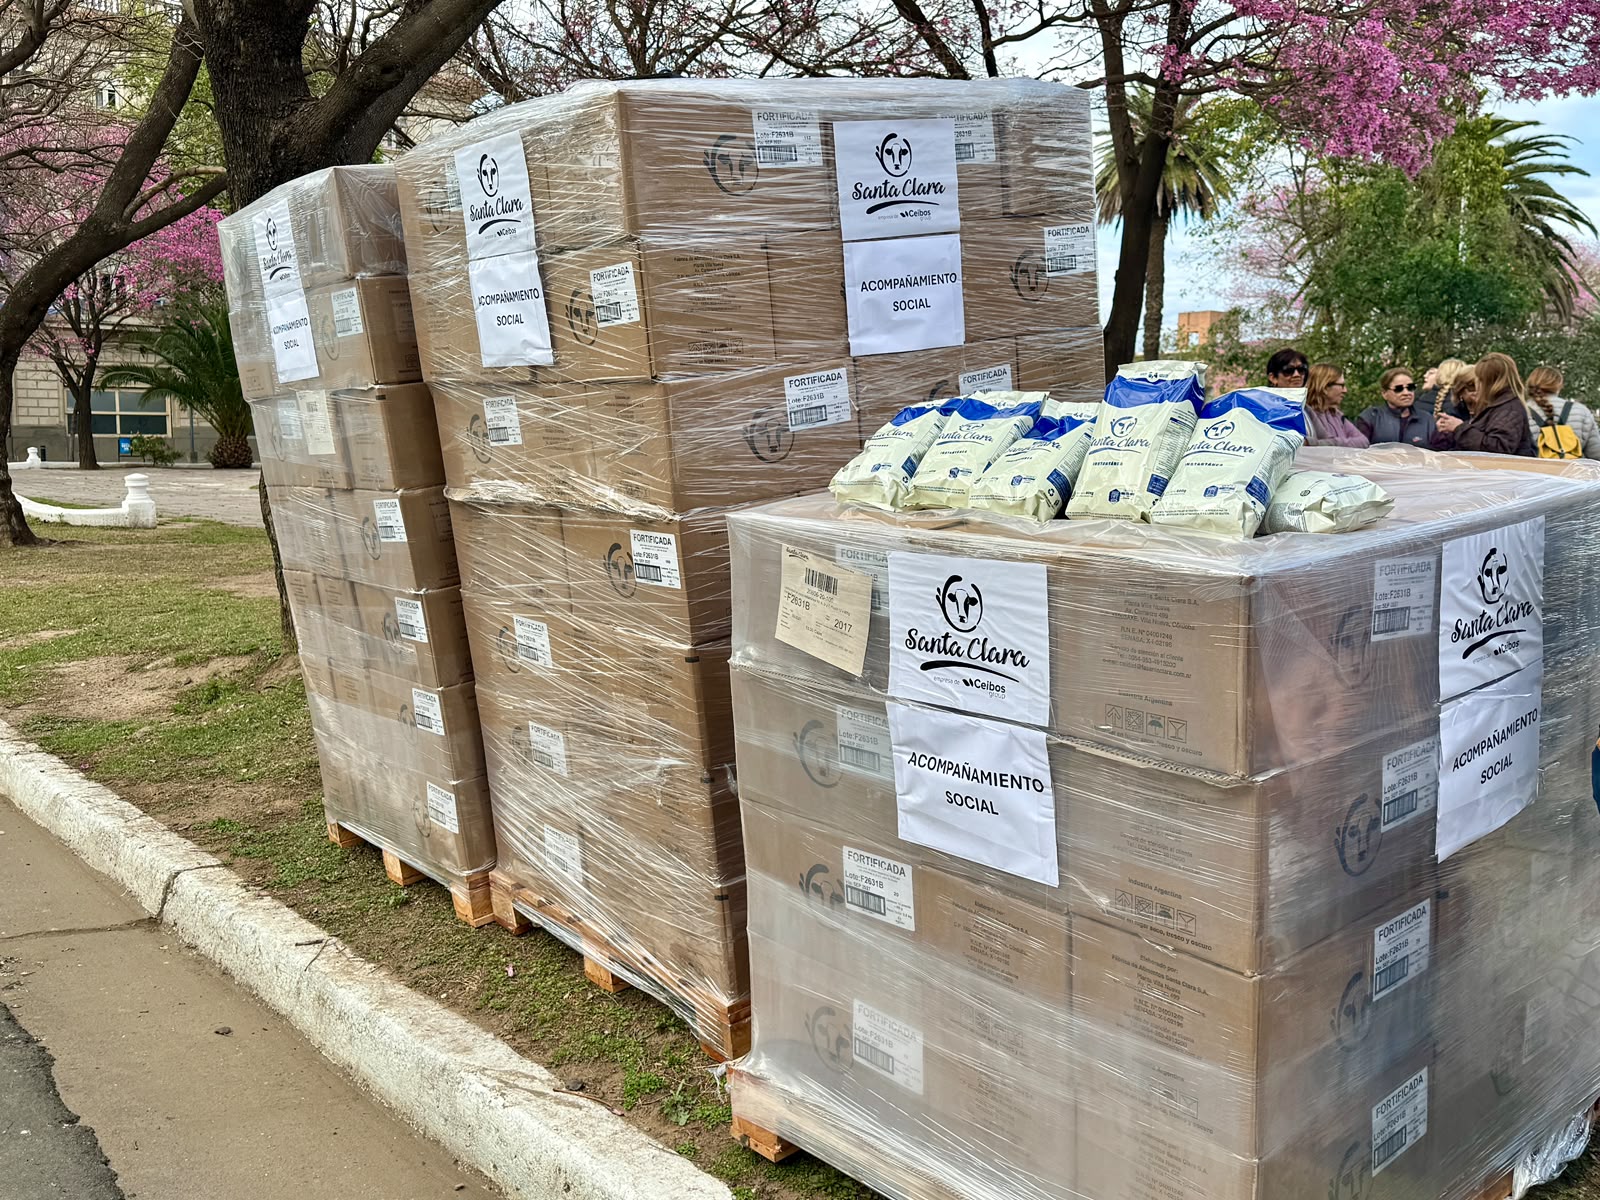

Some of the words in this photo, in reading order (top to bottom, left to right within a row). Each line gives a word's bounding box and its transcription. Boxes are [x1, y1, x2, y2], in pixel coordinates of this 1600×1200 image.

[757, 112, 814, 121] FORTIFICADA
[852, 179, 901, 200] Santa
[902, 177, 946, 197] Clara
[470, 202, 496, 222] Santa
[495, 196, 524, 217] Clara
[908, 209, 931, 218] Ceibos
[1047, 226, 1090, 237] FORTIFICADA
[593, 266, 630, 282] FORTIFICADA
[861, 272, 958, 292] ACOMPAÑAMIENTO
[478, 287, 540, 306] ACOMPAÑAMIENTO
[893, 298, 931, 311] SOCIAL
[496, 313, 525, 327] SOCIAL
[283, 338, 300, 350] SOCIAL
[789, 372, 843, 388] FORTIFICADA
[963, 368, 1008, 384] FORTIFICADA
[939, 430, 962, 439] anta
[963, 431, 993, 442] Clara
[1091, 436, 1117, 447] anta
[1117, 437, 1151, 448] Clara
[1213, 441, 1256, 454] Clara
[633, 533, 672, 546] FORTIFICADA
[1380, 561, 1432, 577] FORTIFICADA
[834, 619, 852, 633] 2017
[1451, 609, 1495, 643] Santa
[1496, 600, 1535, 629] Clara
[905, 628, 964, 657] Santa
[967, 637, 1030, 668] Clara
[933, 676, 953, 684] empresa
[974, 679, 1006, 693] Ceibos
[988, 691, 1006, 699] group
[1452, 708, 1538, 772] ACOMPAÑAMIENTO
[1387, 741, 1435, 770] FORTIFICADA
[908, 752, 1044, 793] ACOMPAÑAMIENTO
[1480, 753, 1513, 784] SOCIAL
[945, 790, 999, 815] SOCIAL
[847, 850, 906, 877] FORTIFICADA
[1378, 906, 1427, 941] FORTIFICADA
[1191, 940, 1212, 951] oscuro
[857, 1004, 917, 1042] FORTIFICADA
[1376, 1074, 1424, 1119] FORTIFICADA
